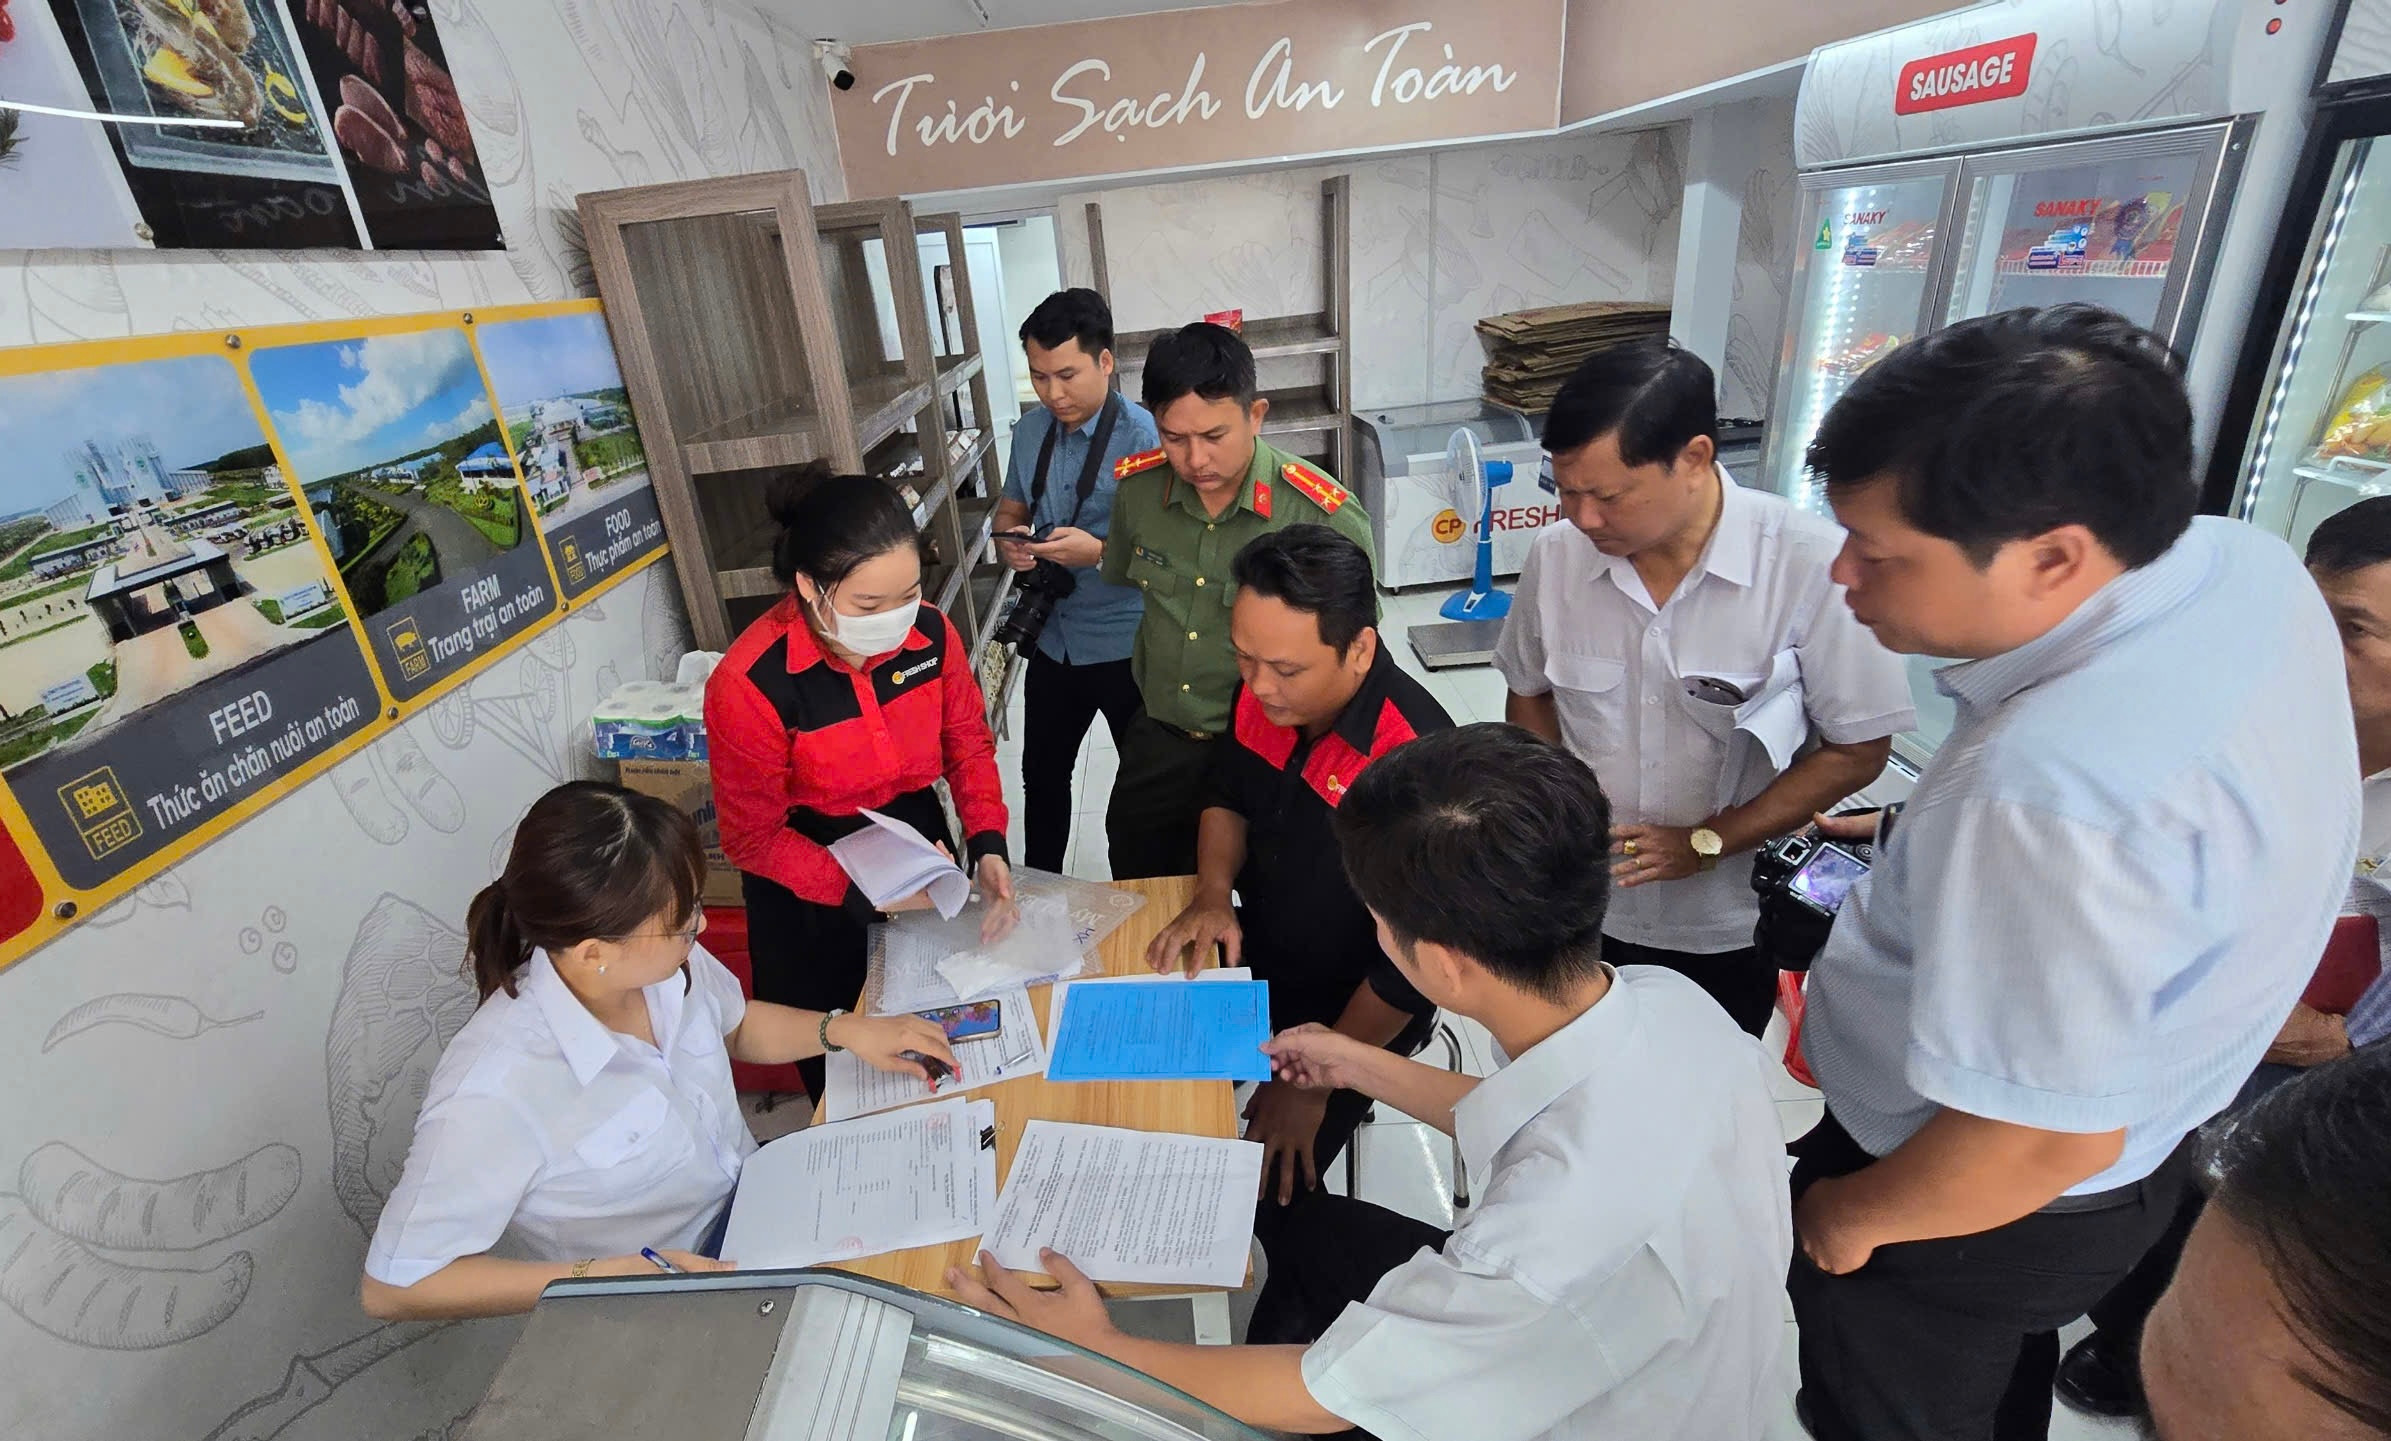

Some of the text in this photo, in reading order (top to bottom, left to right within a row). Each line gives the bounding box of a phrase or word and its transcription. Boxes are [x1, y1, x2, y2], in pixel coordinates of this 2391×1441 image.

[1051, 52, 1221, 147] Sạch
[1244, 37, 1344, 120] An
[1363, 21, 1517, 108] Toàn
[1910, 51, 2017, 101] SAUSAGE
[1843, 210, 1887, 225] SANAKY
[2033, 198, 2102, 218] SANAKY
[604, 508, 632, 537] FOOD
[1435, 503, 1561, 535] CP RESH
[585, 549, 609, 573] Thực
[632, 530, 644, 547] an
[642, 518, 662, 540] toàn
[460, 574, 501, 614] FARM
[427, 585, 545, 663] Trang trại an toàn
[208, 690, 273, 745] FEED
[146, 695, 361, 830] Thức ăn chăn nuôi an toàn
[90, 818, 132, 852] FEED
